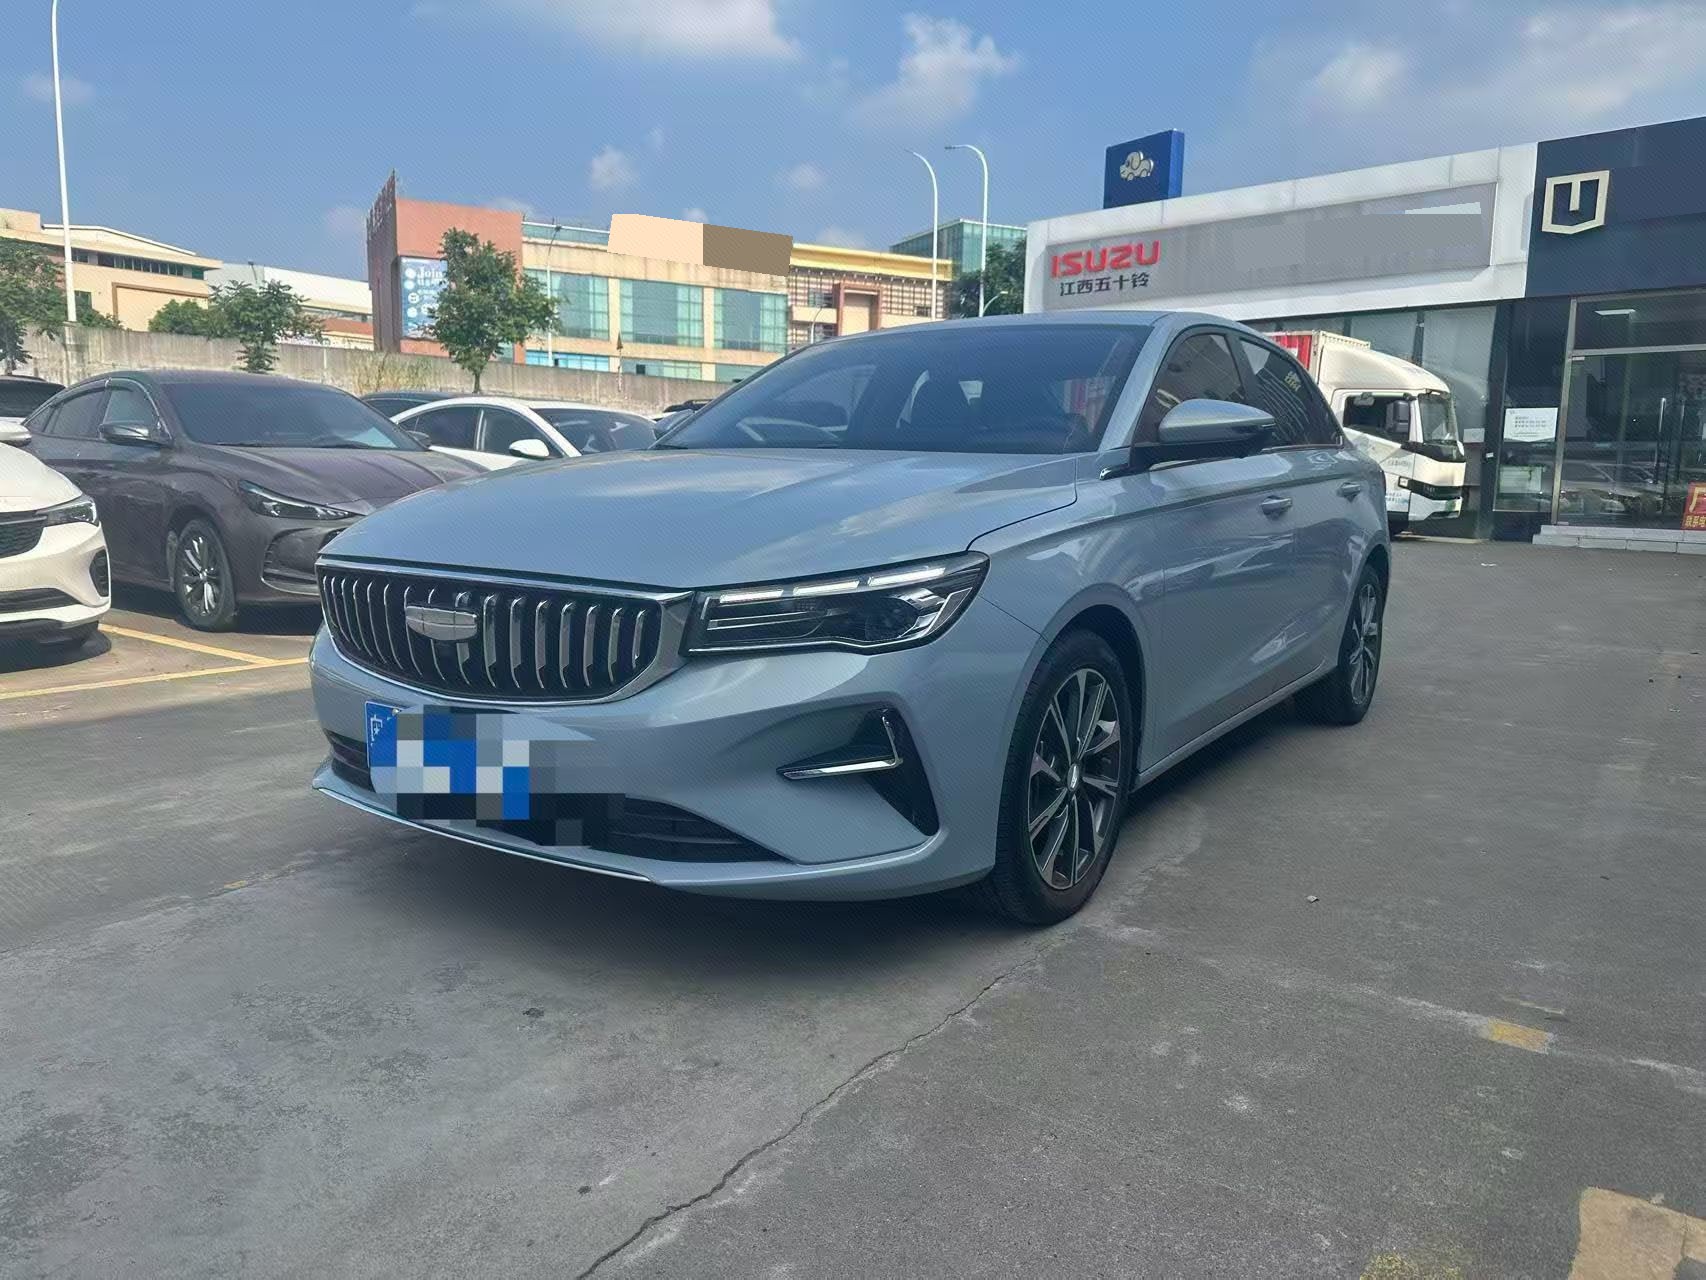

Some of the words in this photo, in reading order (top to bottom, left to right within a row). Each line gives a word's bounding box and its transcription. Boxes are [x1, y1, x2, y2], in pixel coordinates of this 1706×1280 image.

[1051, 240, 1160, 278] ISUZU
[1060, 271, 1149, 296] 江西五十铃
